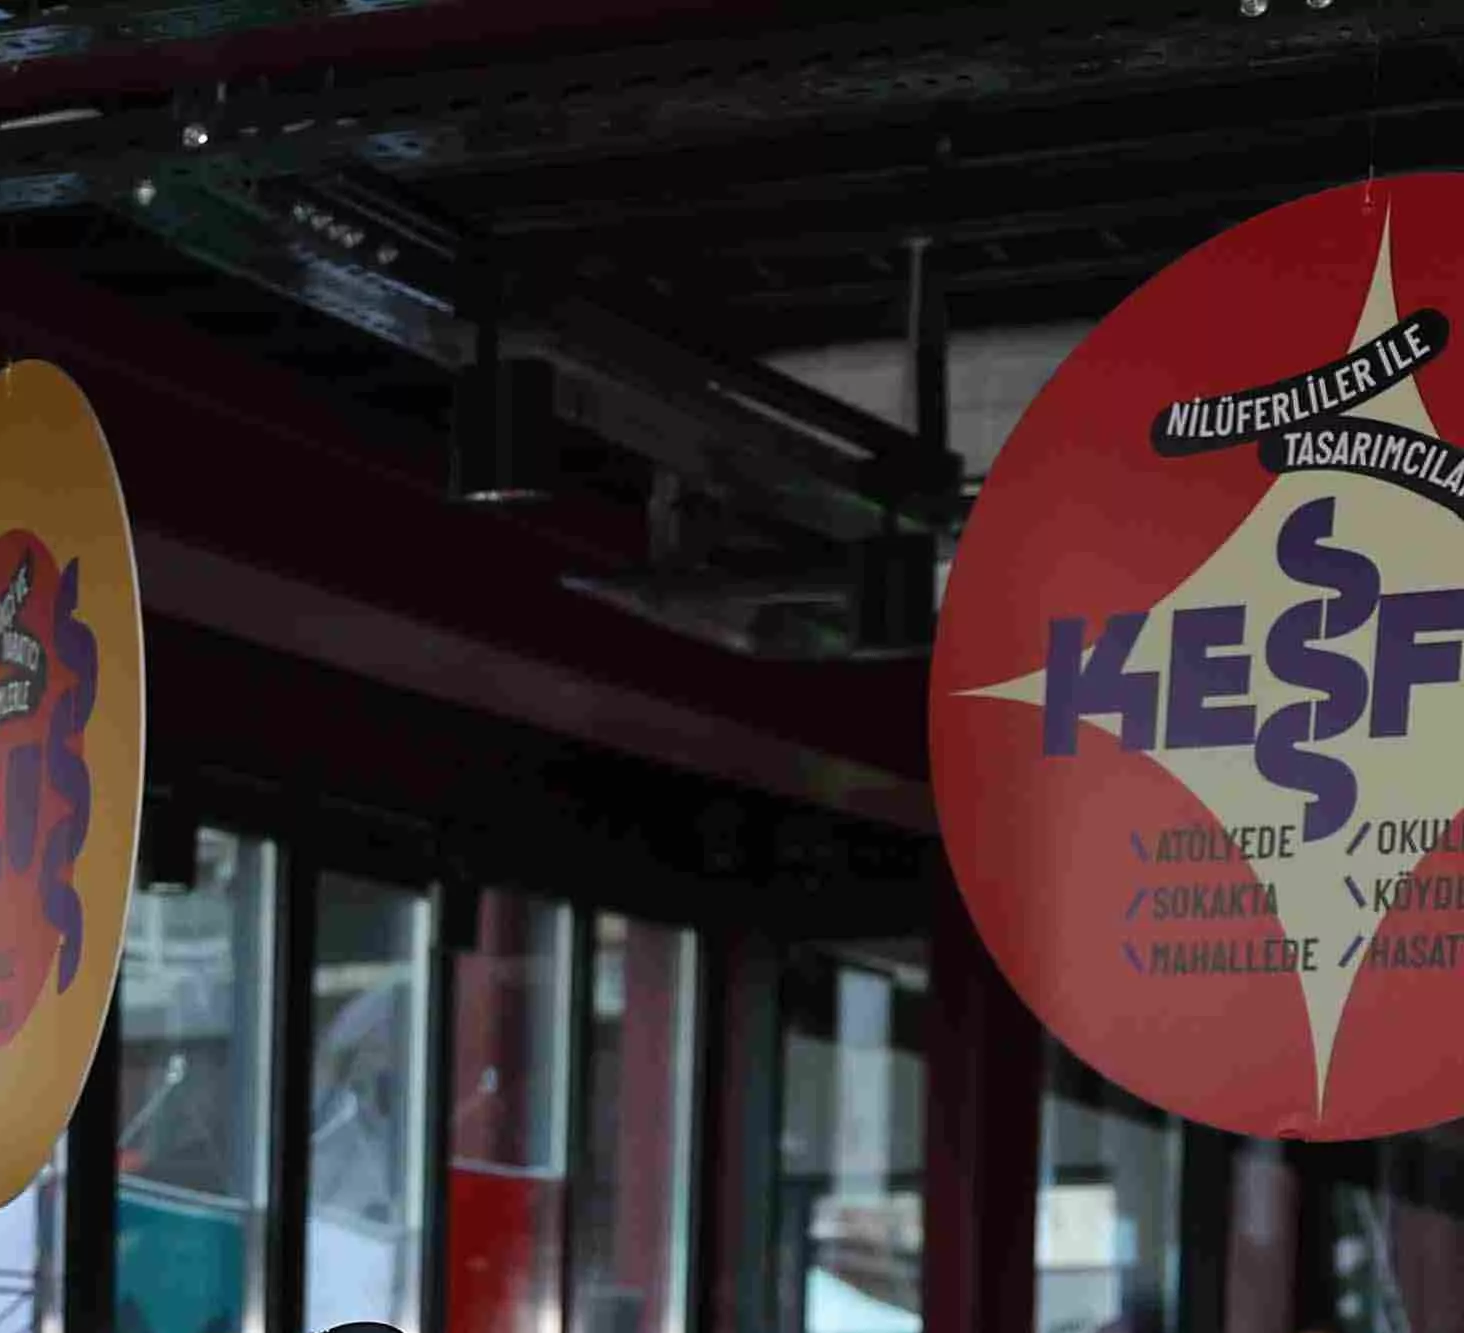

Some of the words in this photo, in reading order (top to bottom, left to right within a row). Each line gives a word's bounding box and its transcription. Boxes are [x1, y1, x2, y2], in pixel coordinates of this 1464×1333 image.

[1166, 357, 1376, 438] NİLÜFERLİLER
[1375, 323, 1431, 377] İLE
[1283, 430, 1464, 499] TASARIMCILA
[1377, 818, 1464, 855] OKUL
[1152, 883, 1278, 921] SOKAKTA
[1150, 938, 1319, 975] MAHALLEDE
